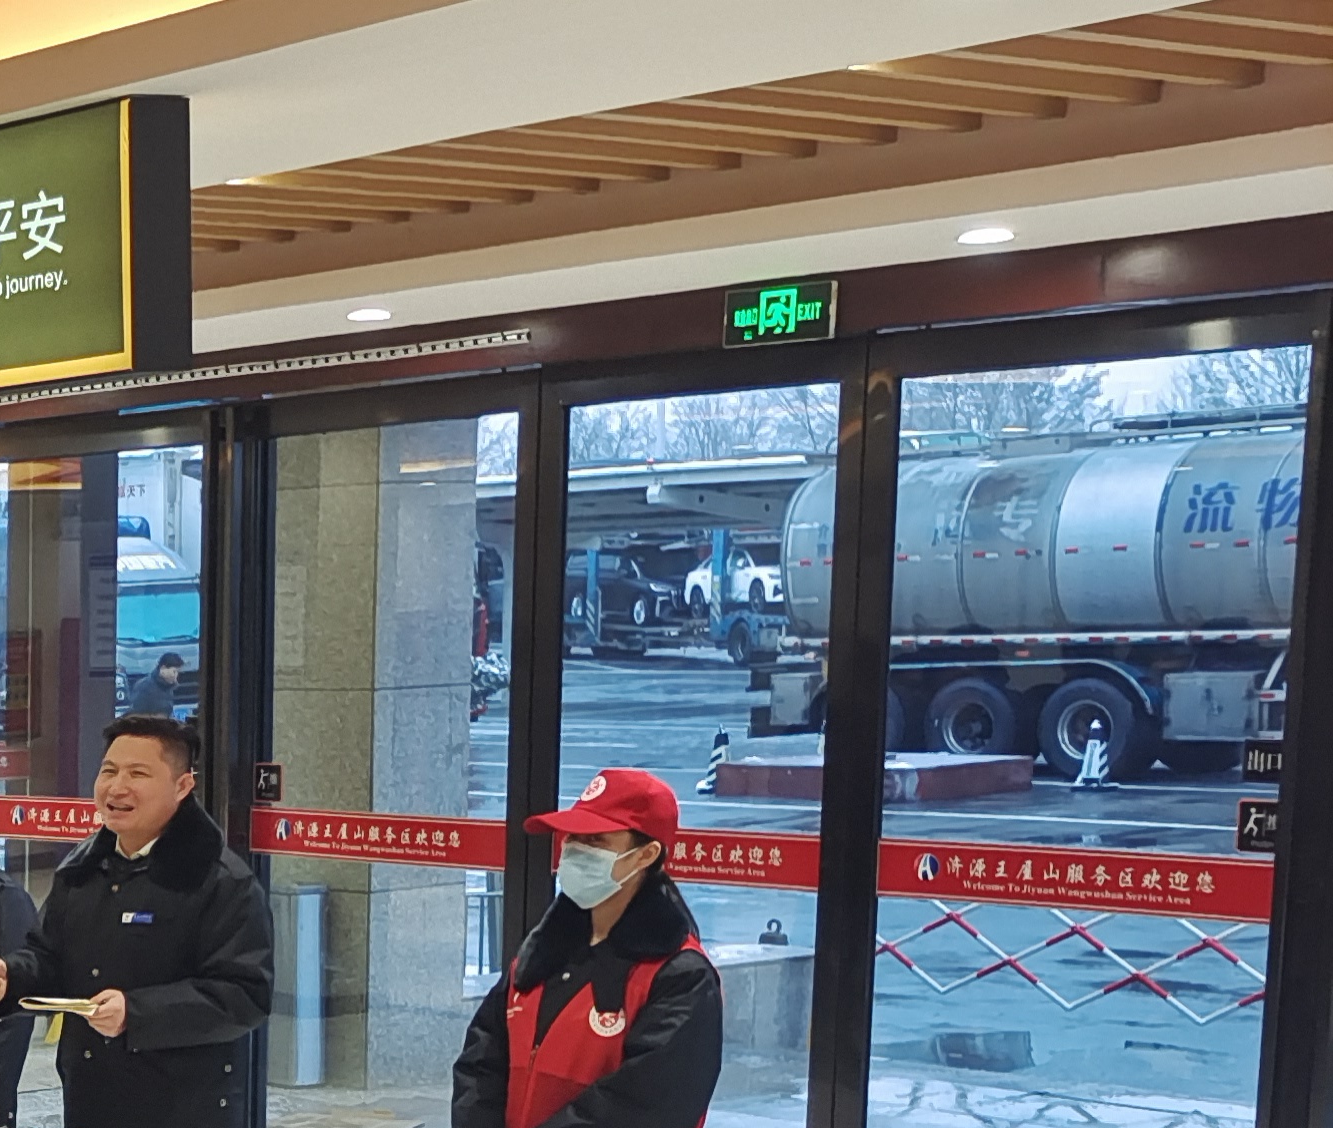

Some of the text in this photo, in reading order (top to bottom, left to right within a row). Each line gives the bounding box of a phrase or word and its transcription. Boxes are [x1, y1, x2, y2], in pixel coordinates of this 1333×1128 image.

[796, 301, 822, 322] EXIT
[963, 880, 1006, 892] Welcome
[1008, 882, 1021, 893] To
